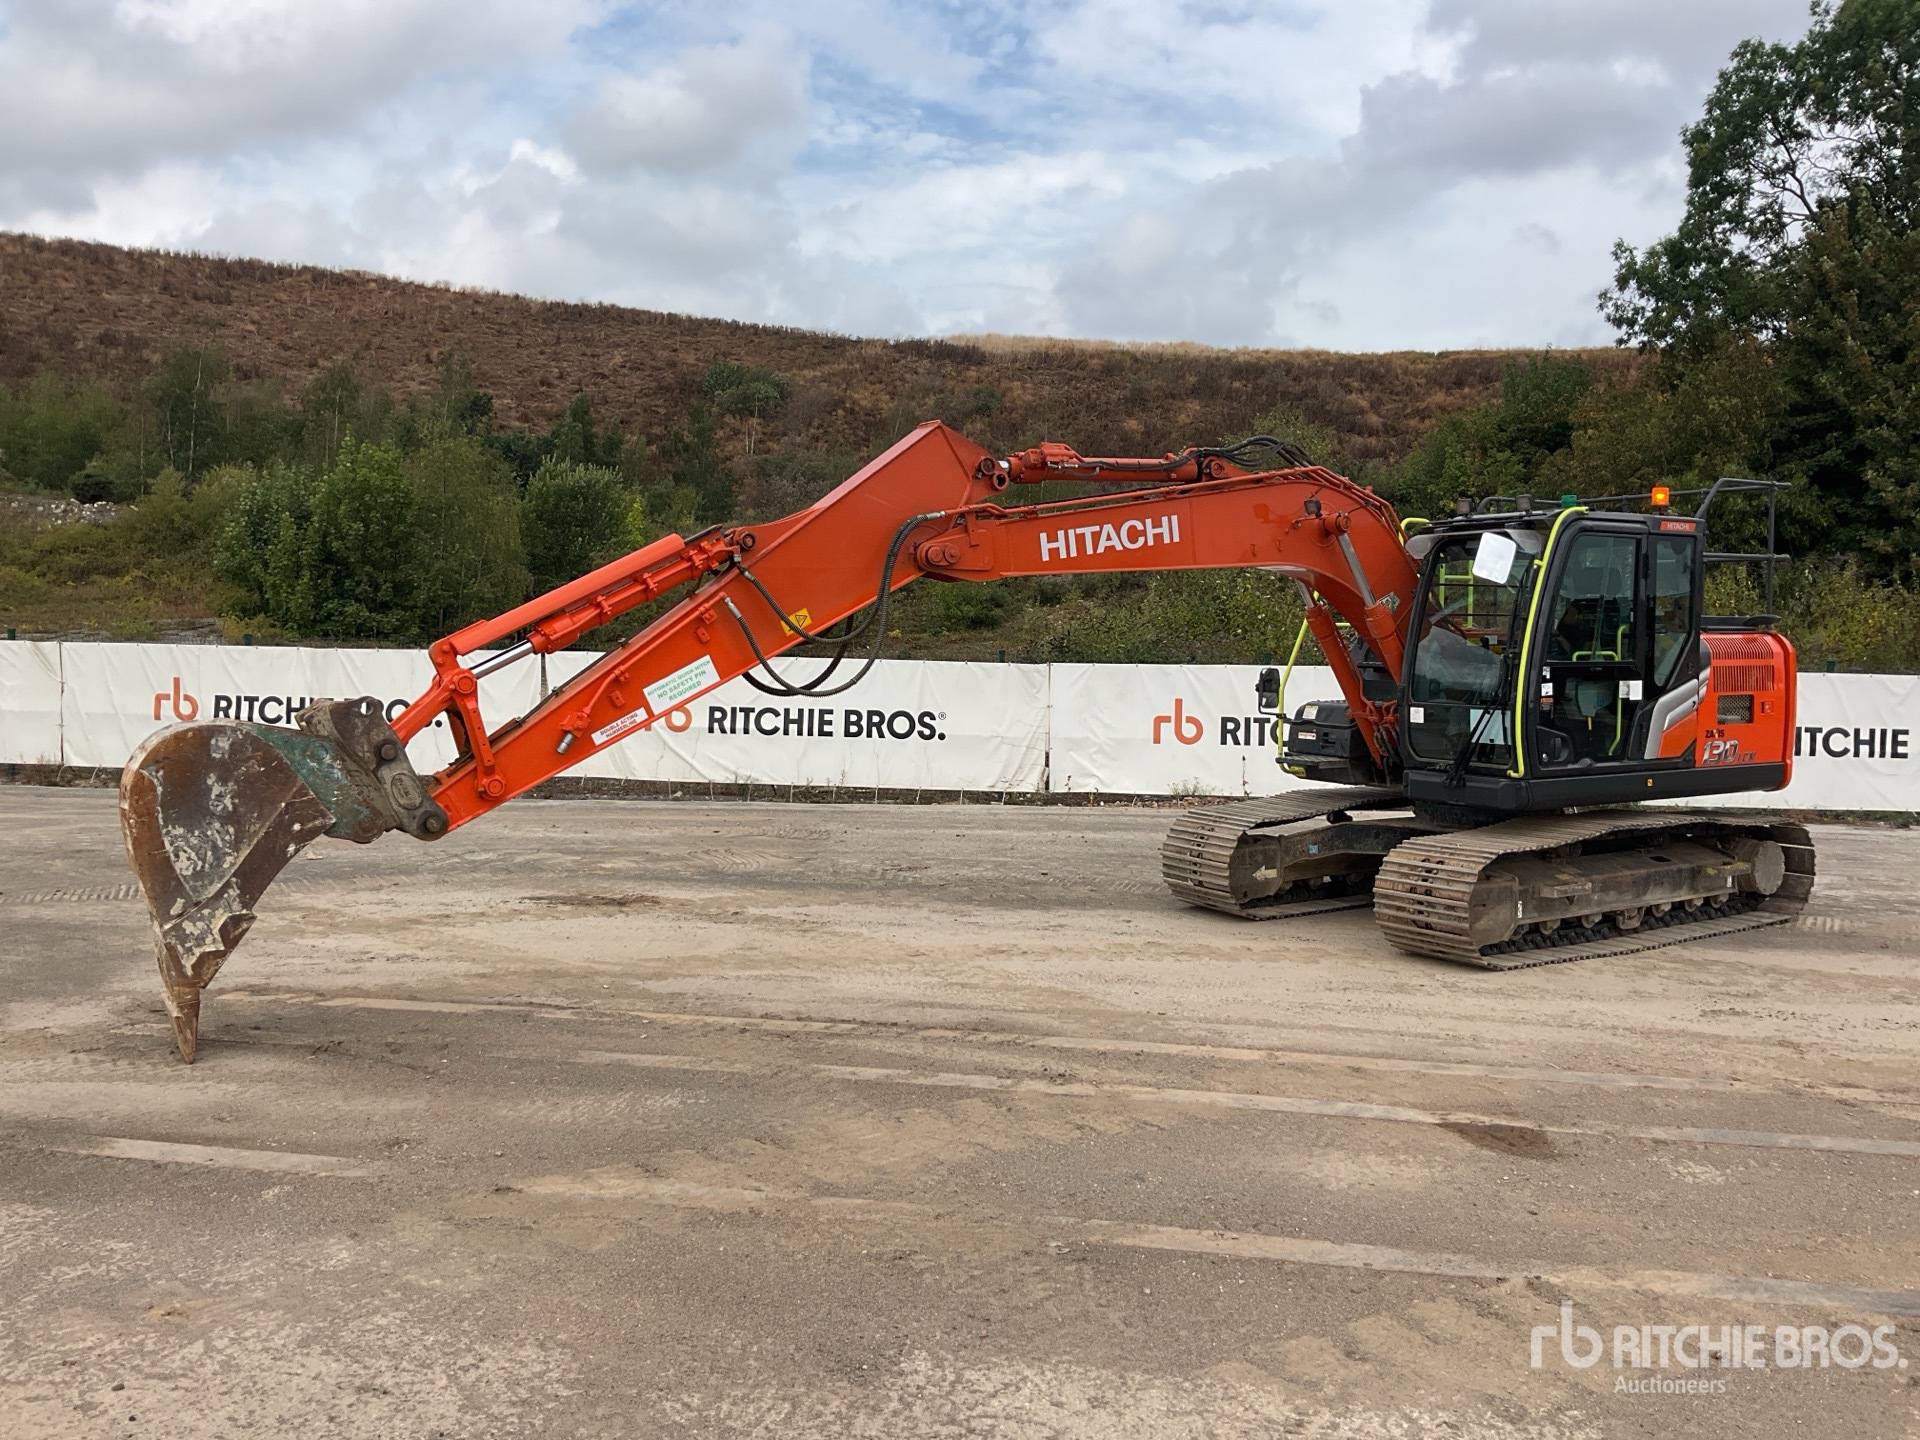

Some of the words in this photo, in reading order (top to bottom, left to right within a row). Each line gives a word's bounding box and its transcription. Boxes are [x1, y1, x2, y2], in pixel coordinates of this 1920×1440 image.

[1040, 514, 1180, 562] HITACHI
[1667, 522, 1690, 531] HITACHI
[647, 678, 677, 696] AUTOMATIC
[677, 669, 694, 680] QUICK
[694, 660, 711, 672] HITCH
[657, 690, 668, 699] NO
[669, 676, 694, 693] SAFETY
[694, 669, 707, 680] PIN
[668, 680, 702, 701] REQUIRED
[154, 677, 199, 721] rb
[213, 694, 334, 724] RITCH
[600, 722, 620, 736] DOUBLE
[619, 712, 639, 725] ACTING
[605, 719, 638, 738] HAMMERLINE
[708, 705, 835, 737] RITCHIE
[1153, 698, 1204, 745] rb
[1702, 740, 1739, 765] 130
[1794, 726, 1910, 759] ITCHIE
